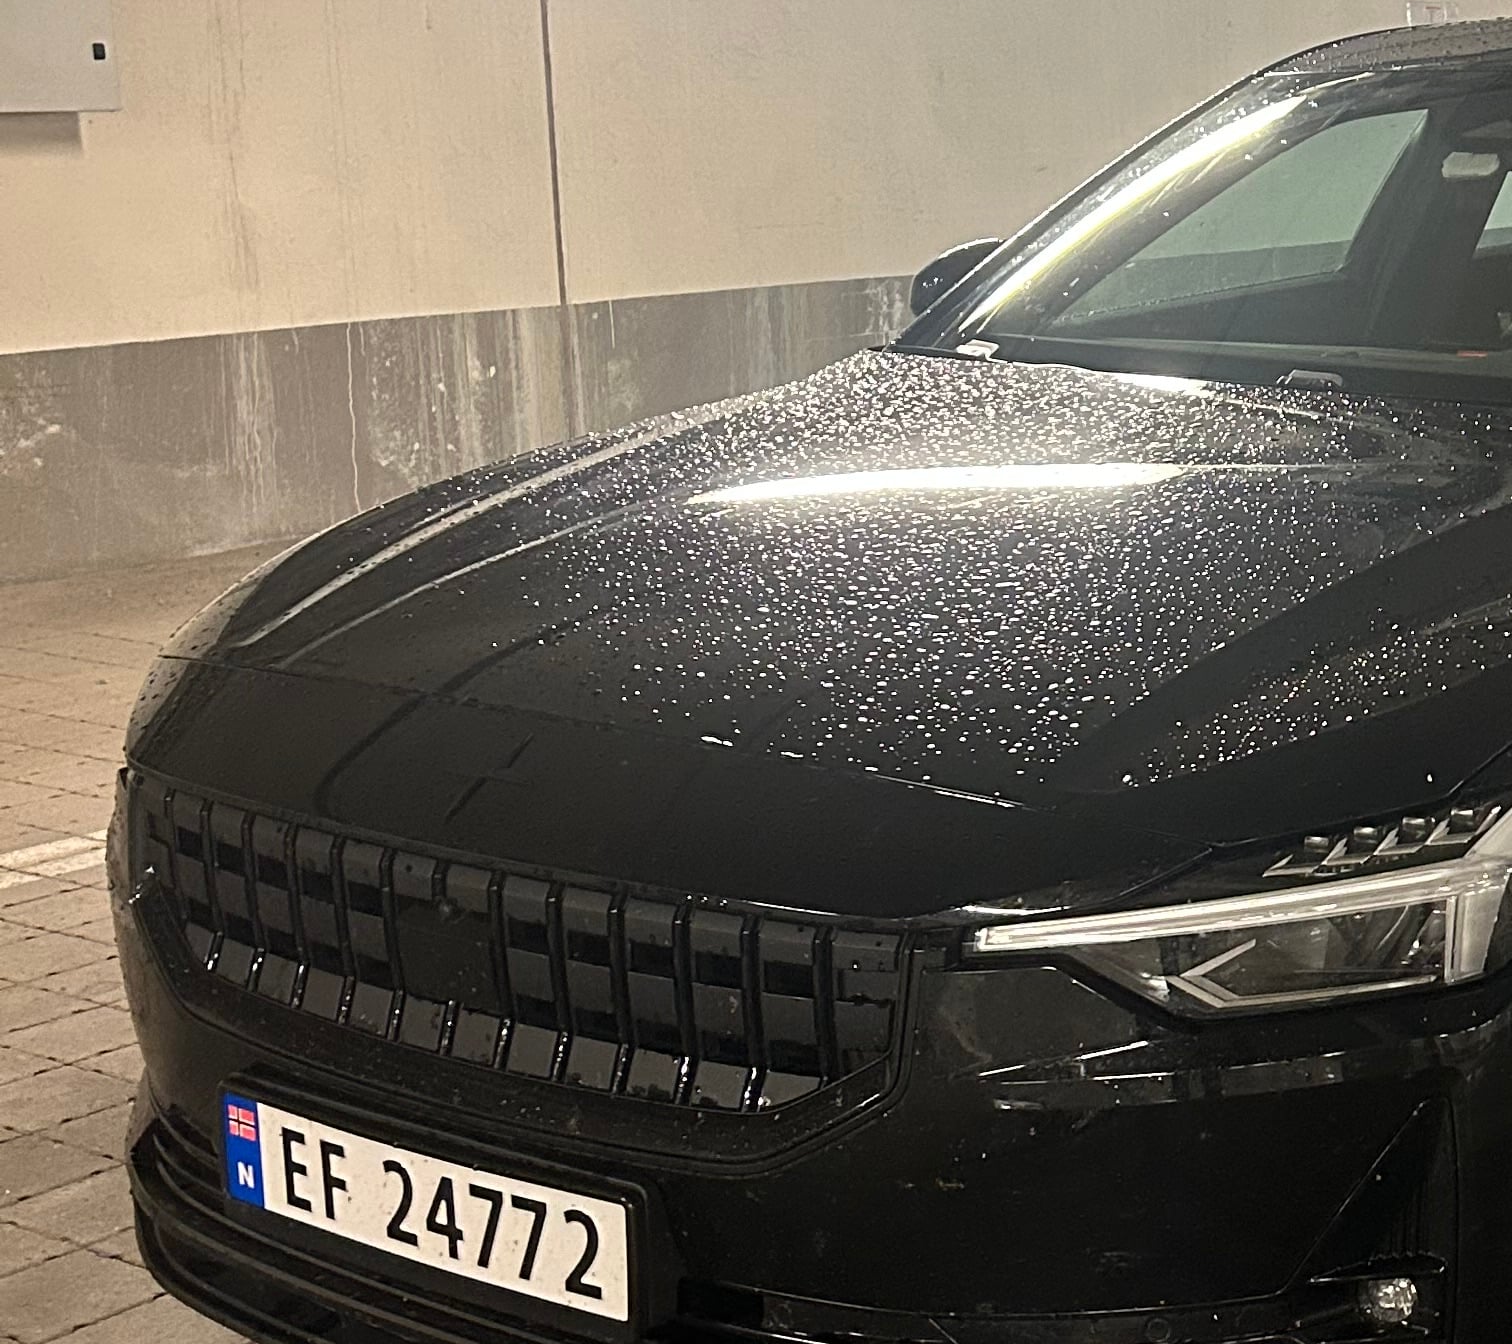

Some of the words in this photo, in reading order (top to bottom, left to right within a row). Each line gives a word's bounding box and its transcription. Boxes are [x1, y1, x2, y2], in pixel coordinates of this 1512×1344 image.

[238, 1161, 255, 1188] N
[281, 1127, 347, 1220] EF
[382, 1159, 602, 1300] 24772
